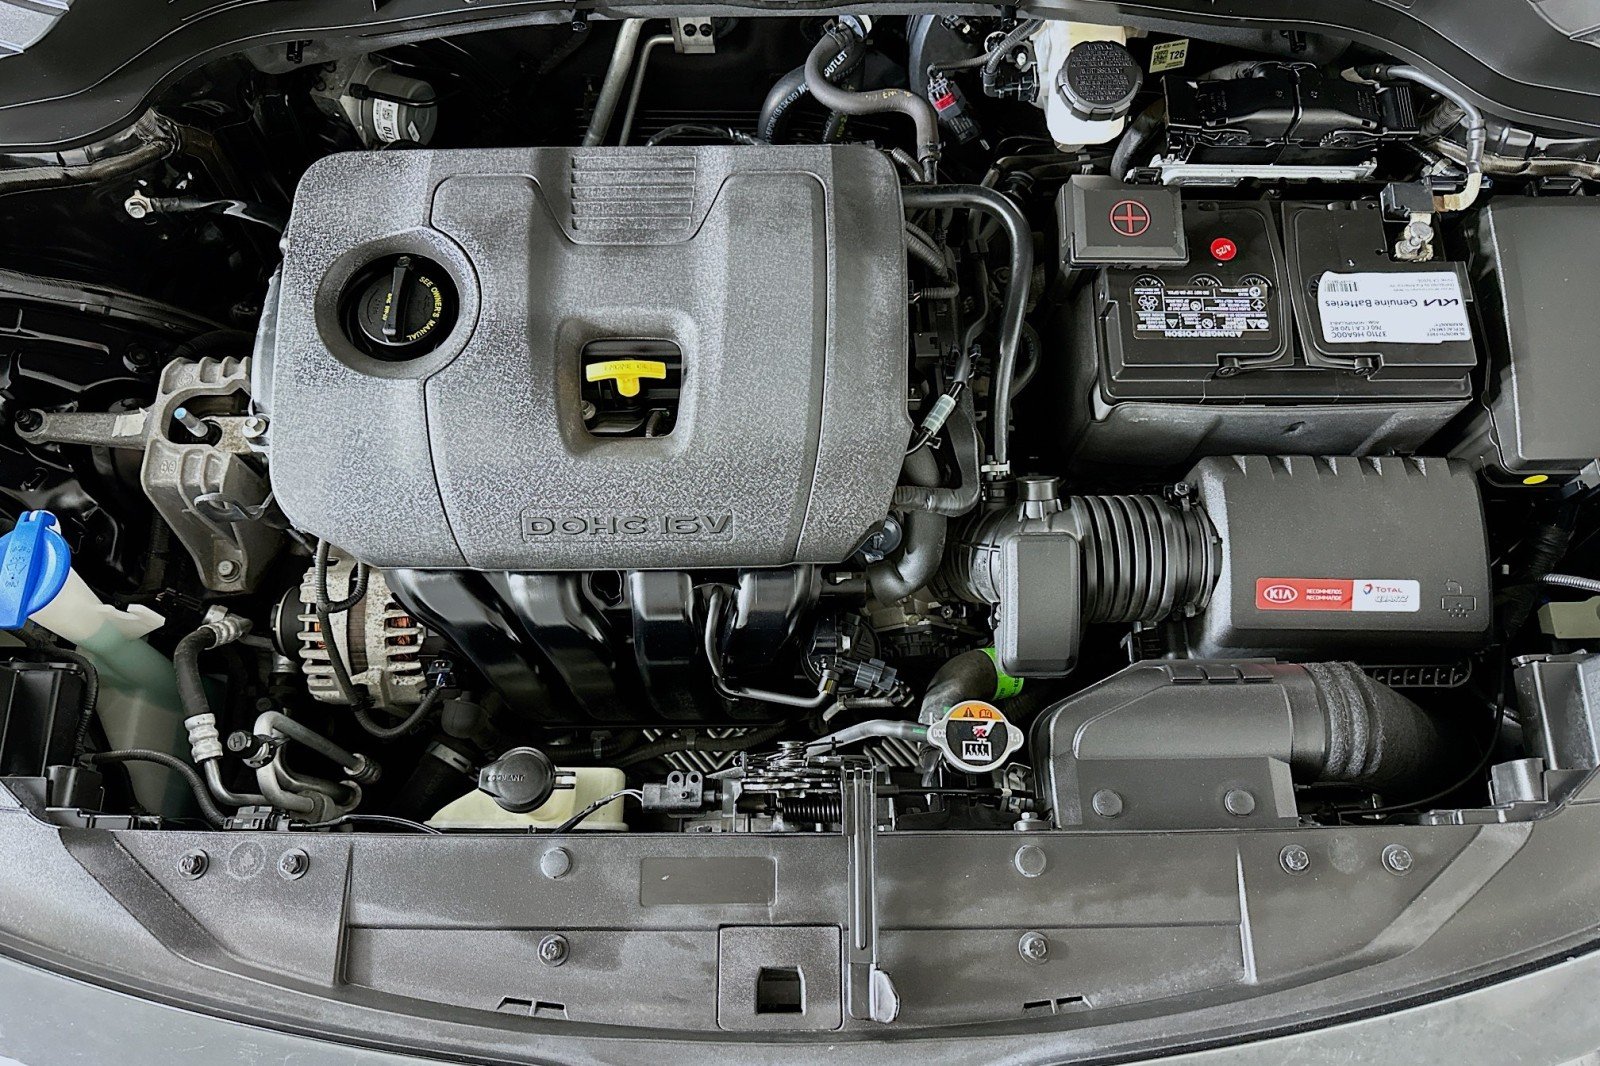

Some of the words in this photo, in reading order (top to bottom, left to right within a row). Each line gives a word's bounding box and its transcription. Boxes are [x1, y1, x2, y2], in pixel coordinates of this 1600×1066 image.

[1169, 49, 1185, 60] T26
[418, 276, 434, 288] SEE
[430, 286, 442, 318] OWNER'S
[1325, 300, 1372, 308] Batteries
[1374, 299, 1418, 308] Genuine
[1423, 298, 1459, 307] KIA
[406, 319, 437, 341] MANUAL
[525, 516, 647, 535] DOHC
[659, 515, 730, 534] 16V
[1269, 588, 1292, 600] KIA
